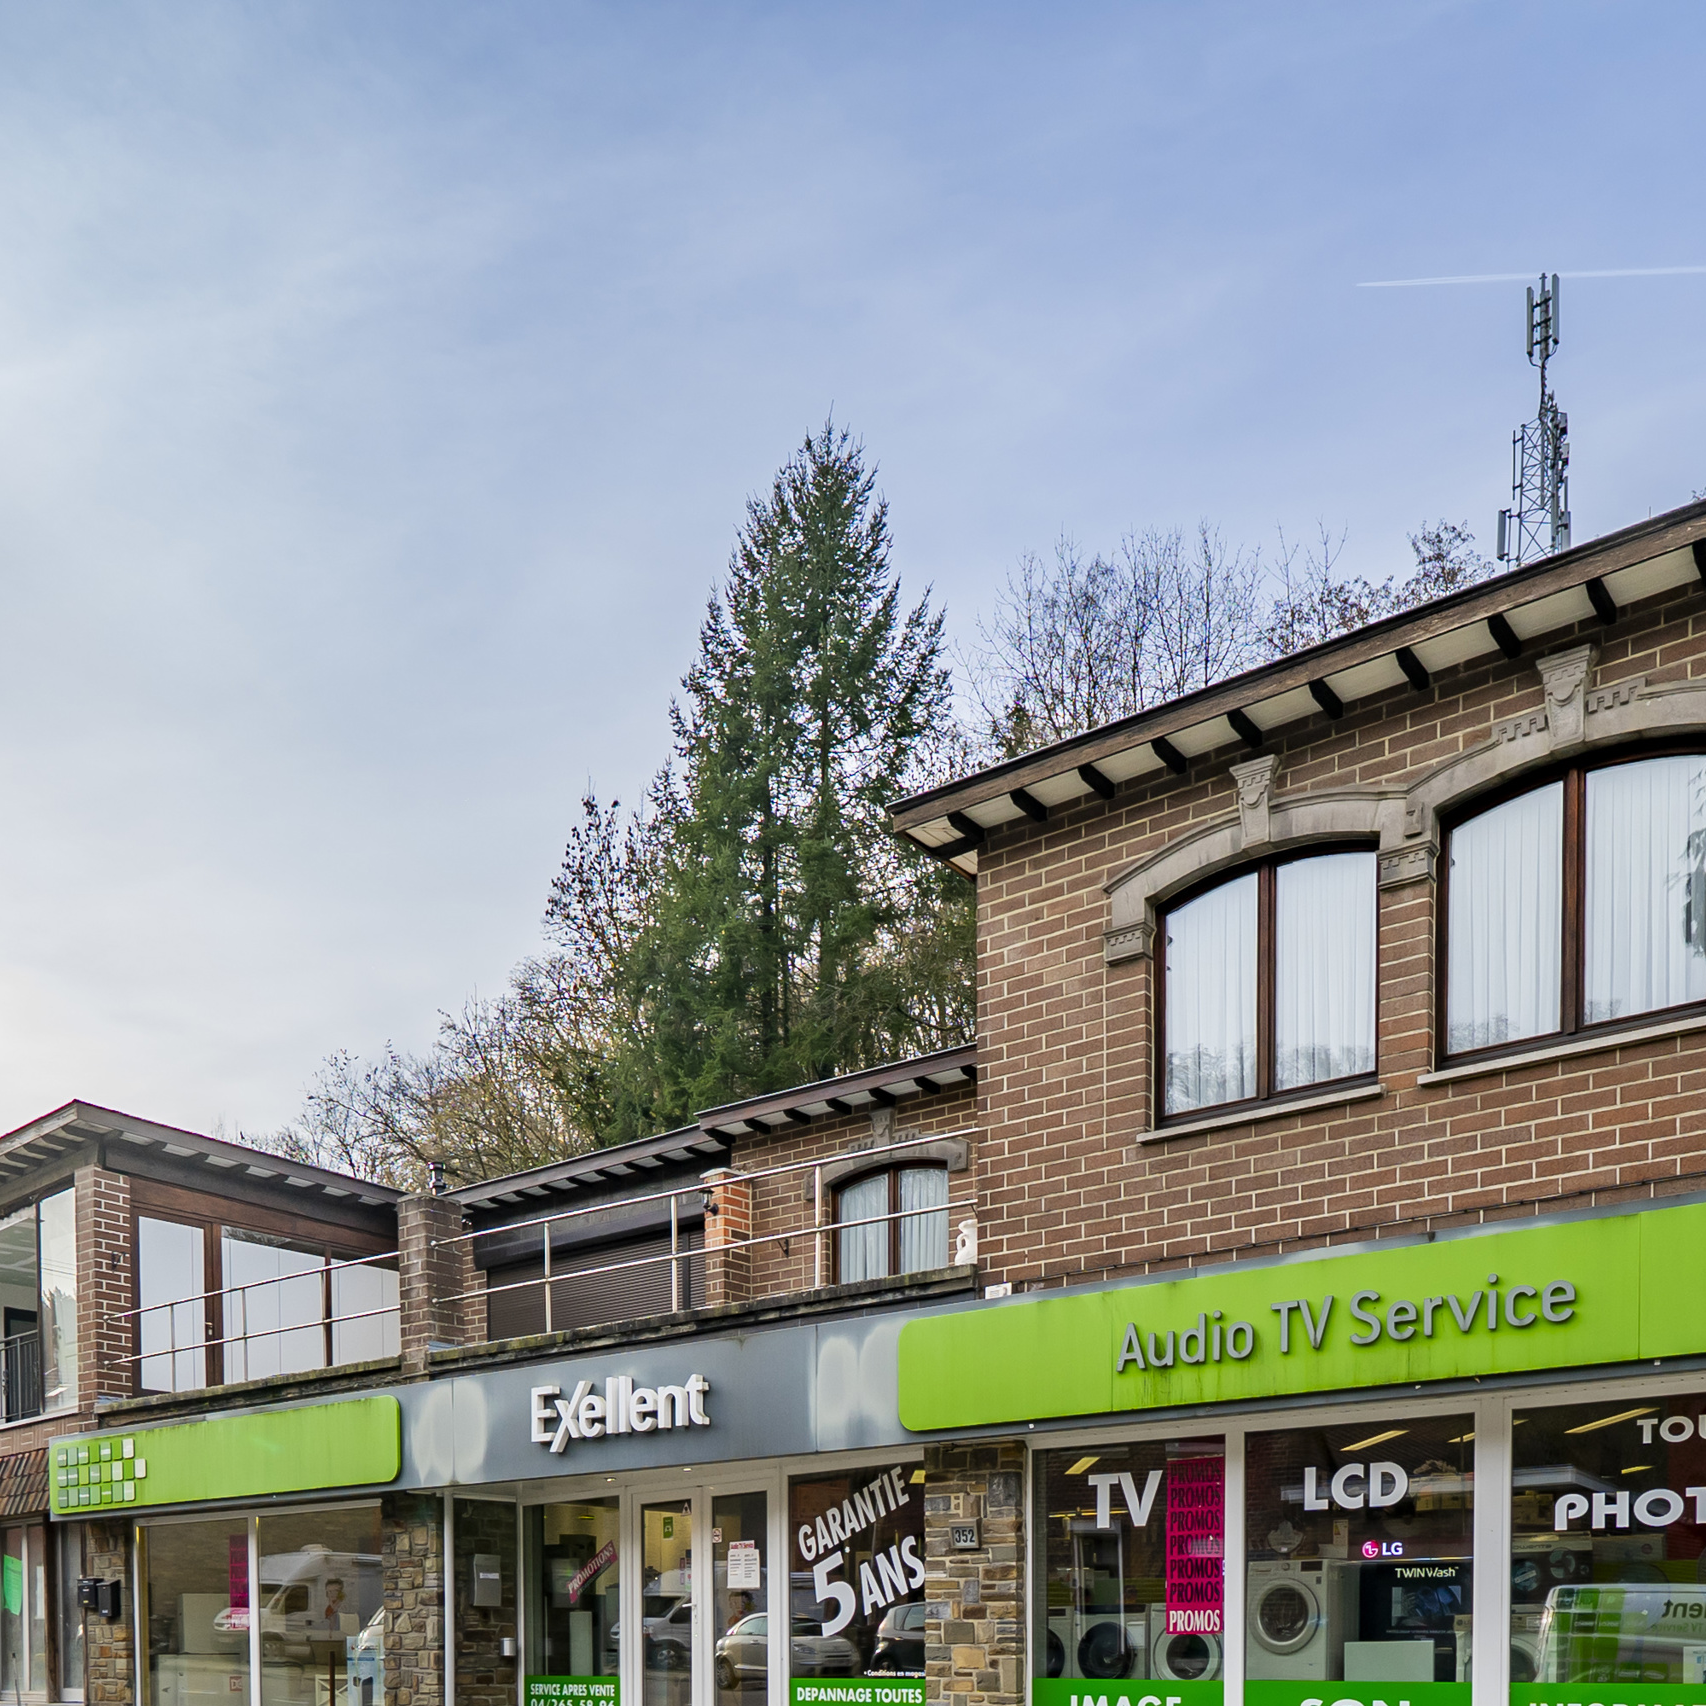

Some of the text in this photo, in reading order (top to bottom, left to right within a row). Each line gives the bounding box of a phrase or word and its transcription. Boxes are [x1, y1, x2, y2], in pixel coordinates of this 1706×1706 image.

[1116, 1273, 1576, 1372] Audio TV Service
[1304, 1461, 1408, 1511] LCD
[1088, 1470, 1163, 1529] TV
[798, 1466, 910, 1561] GARANTIE
[1170, 1509, 1221, 1532] PROMOS
[955, 1528, 975, 1543] 352
[1170, 1532, 1221, 1556] PROMOS
[1382, 1542, 1403, 1556] LG
[569, 1543, 613, 1594] PROMOTIONS
[1169, 1557, 1221, 1580] PROMOS
[813, 1535, 925, 1637] 5 ANS
[1169, 1580, 1221, 1603] PROMOS
[1169, 1609, 1221, 1632] PROMOS
[530, 1683, 615, 1697] SERVICE APRES VENTE
[797, 1687, 923, 1704] DEPANNAGE TOUTES
